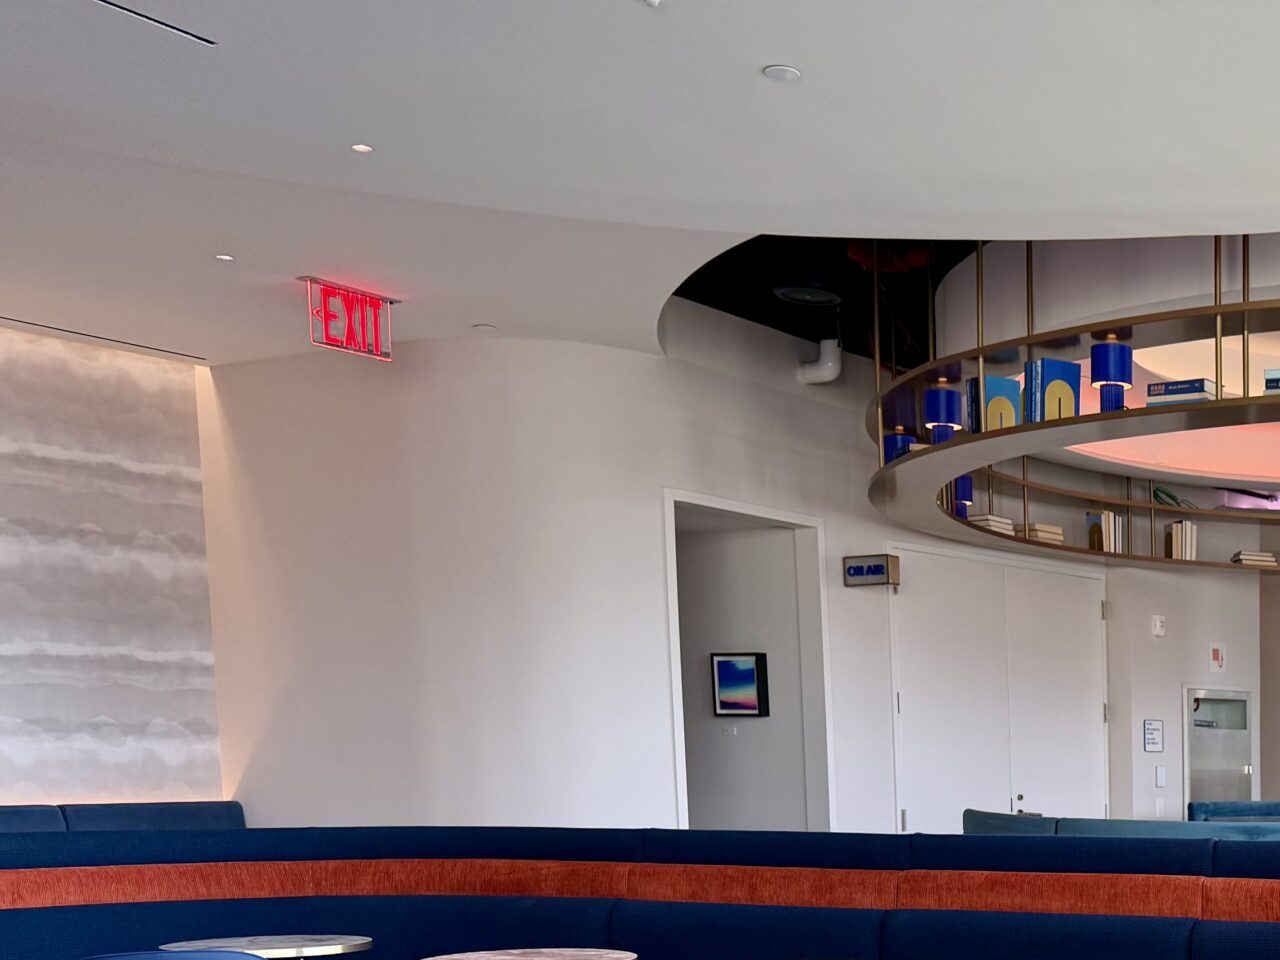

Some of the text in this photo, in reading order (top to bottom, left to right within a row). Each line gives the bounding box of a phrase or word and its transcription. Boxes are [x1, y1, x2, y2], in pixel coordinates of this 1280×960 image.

[321, 286, 384, 354] EXIT
[847, 564, 885, 577] ON AIR
